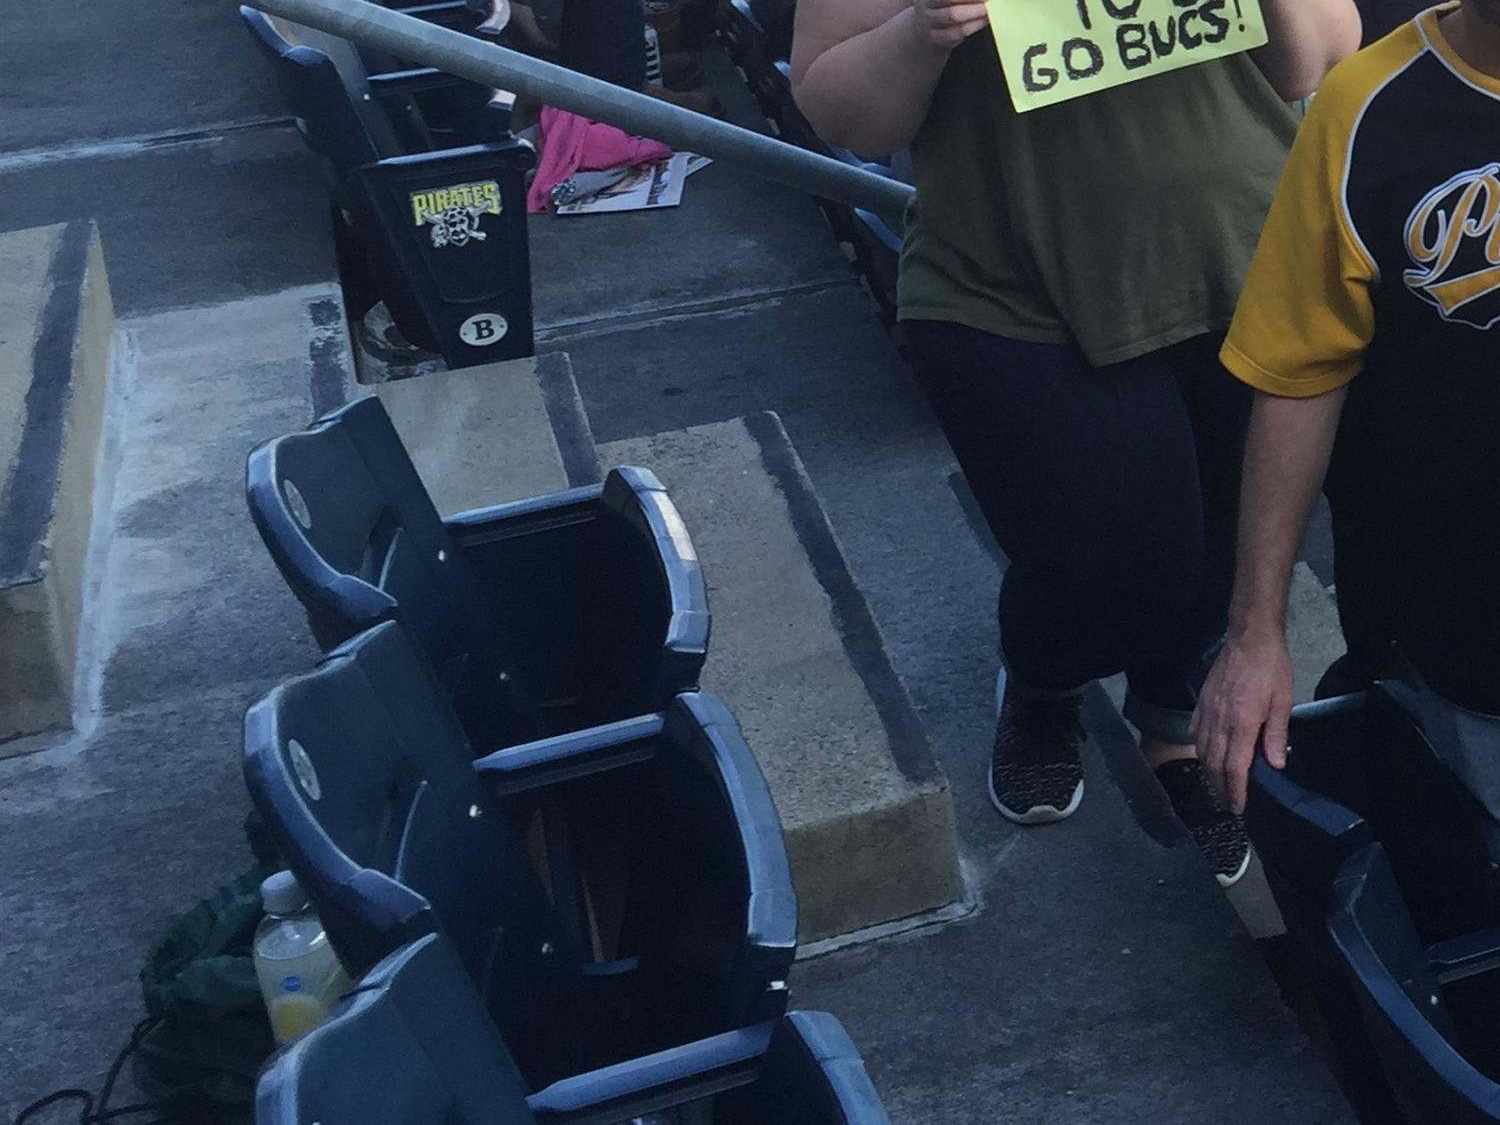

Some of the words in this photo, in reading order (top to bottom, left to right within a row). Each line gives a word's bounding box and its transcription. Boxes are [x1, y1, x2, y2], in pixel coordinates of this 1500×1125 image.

[1022, 37, 1104, 93] GO
[410, 181, 502, 227] PIRATES
[472, 319, 495, 341] B
